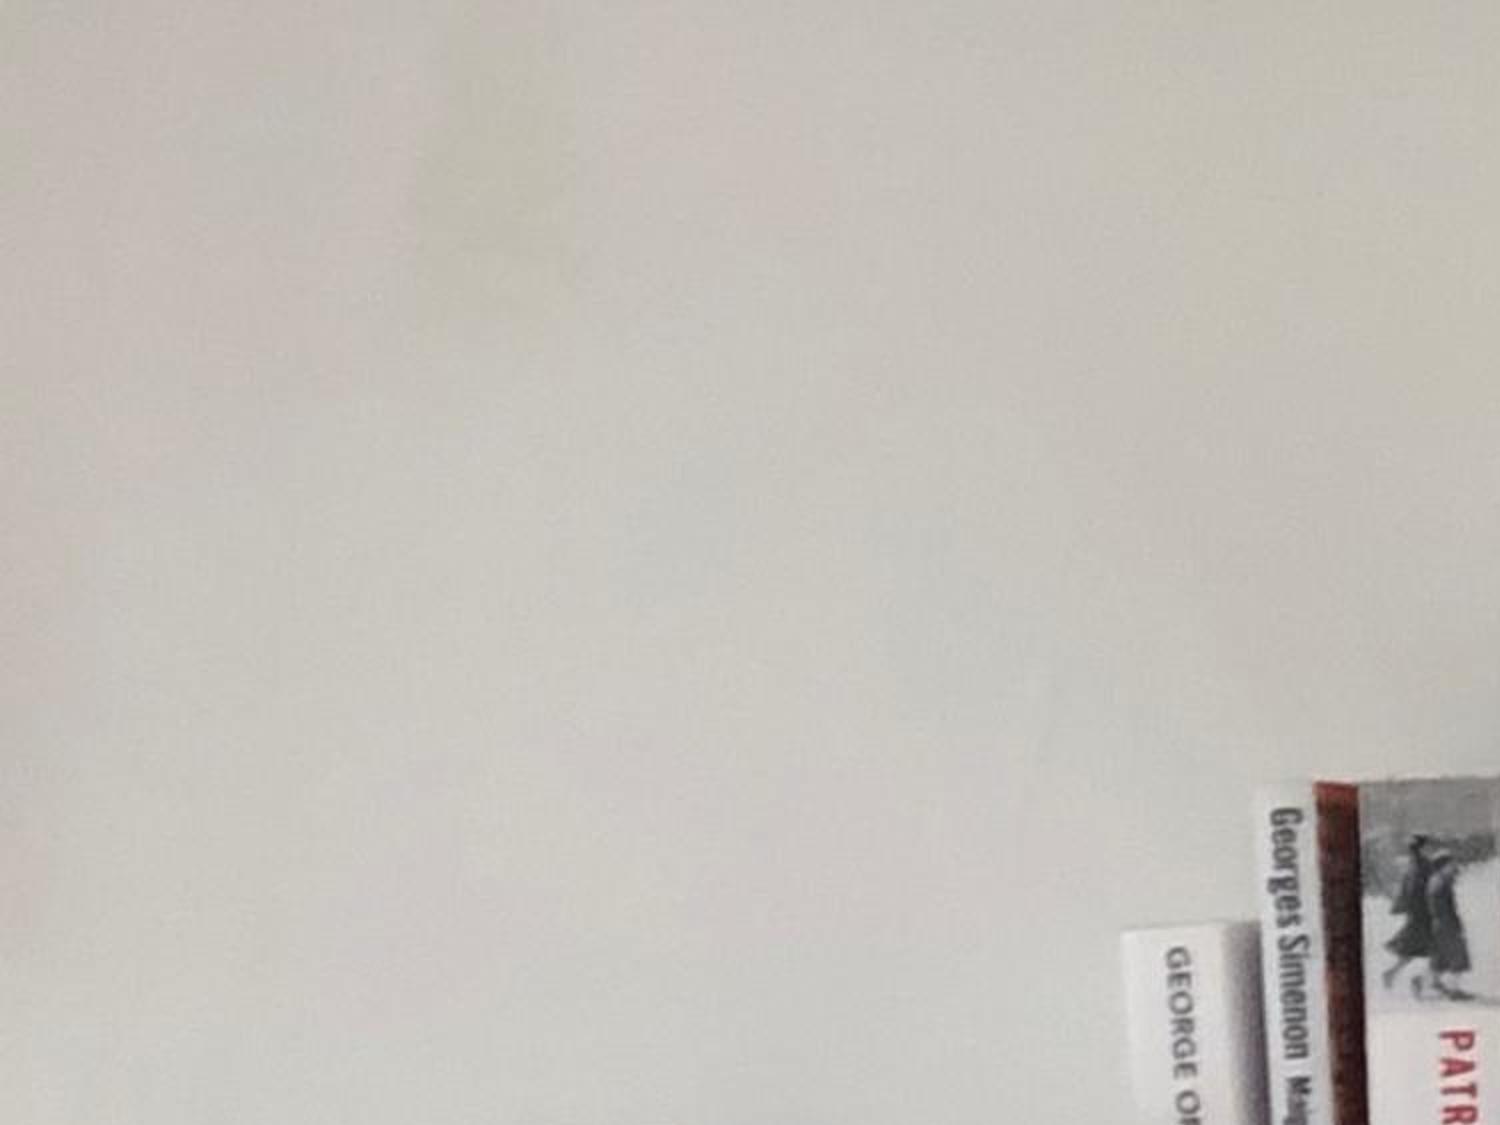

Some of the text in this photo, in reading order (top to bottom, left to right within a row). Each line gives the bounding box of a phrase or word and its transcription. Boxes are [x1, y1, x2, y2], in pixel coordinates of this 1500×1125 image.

[1165, 945, 1198, 1080] GEORGE
[1267, 806, 1312, 1061] Georges Simenon
